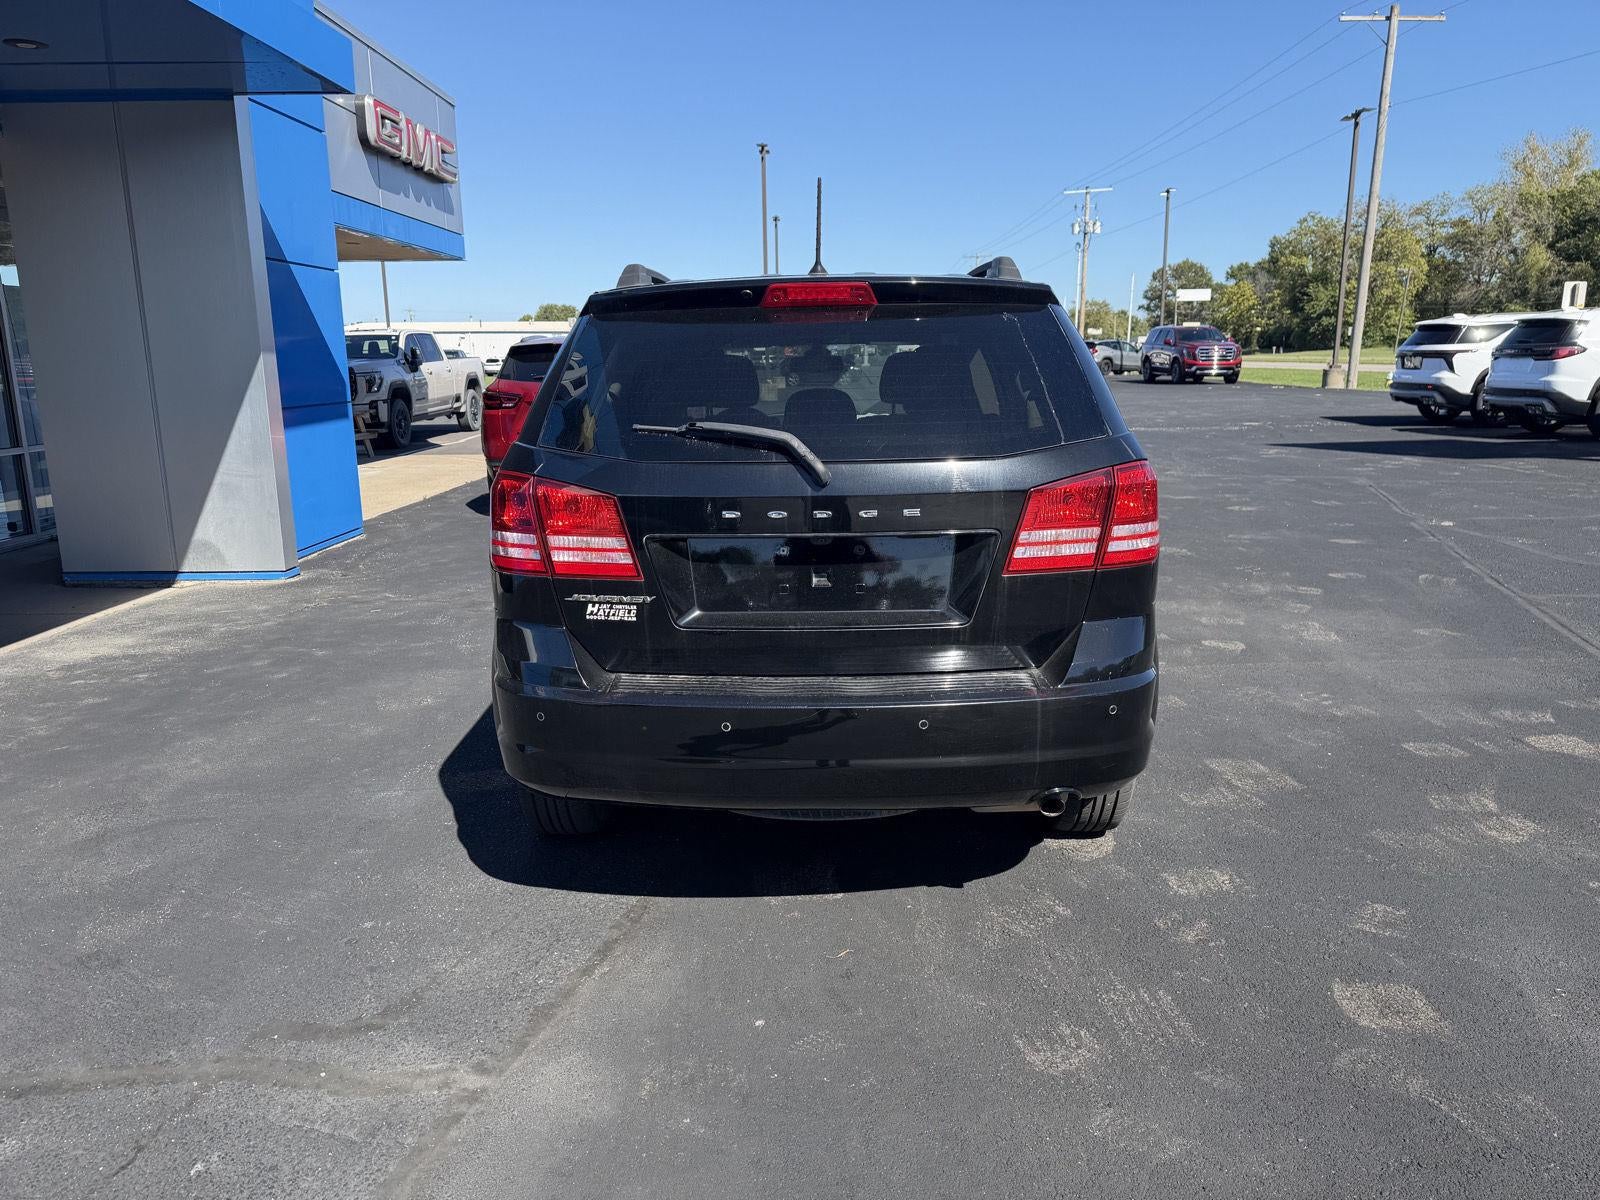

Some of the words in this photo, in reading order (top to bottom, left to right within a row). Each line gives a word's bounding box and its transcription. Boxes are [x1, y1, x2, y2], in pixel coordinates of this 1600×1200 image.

[355, 94, 459, 184] GMC
[721, 508, 921, 519] DODGE
[564, 594, 656, 603] JOURNEY
[586, 604, 637, 617] HATFIELD
